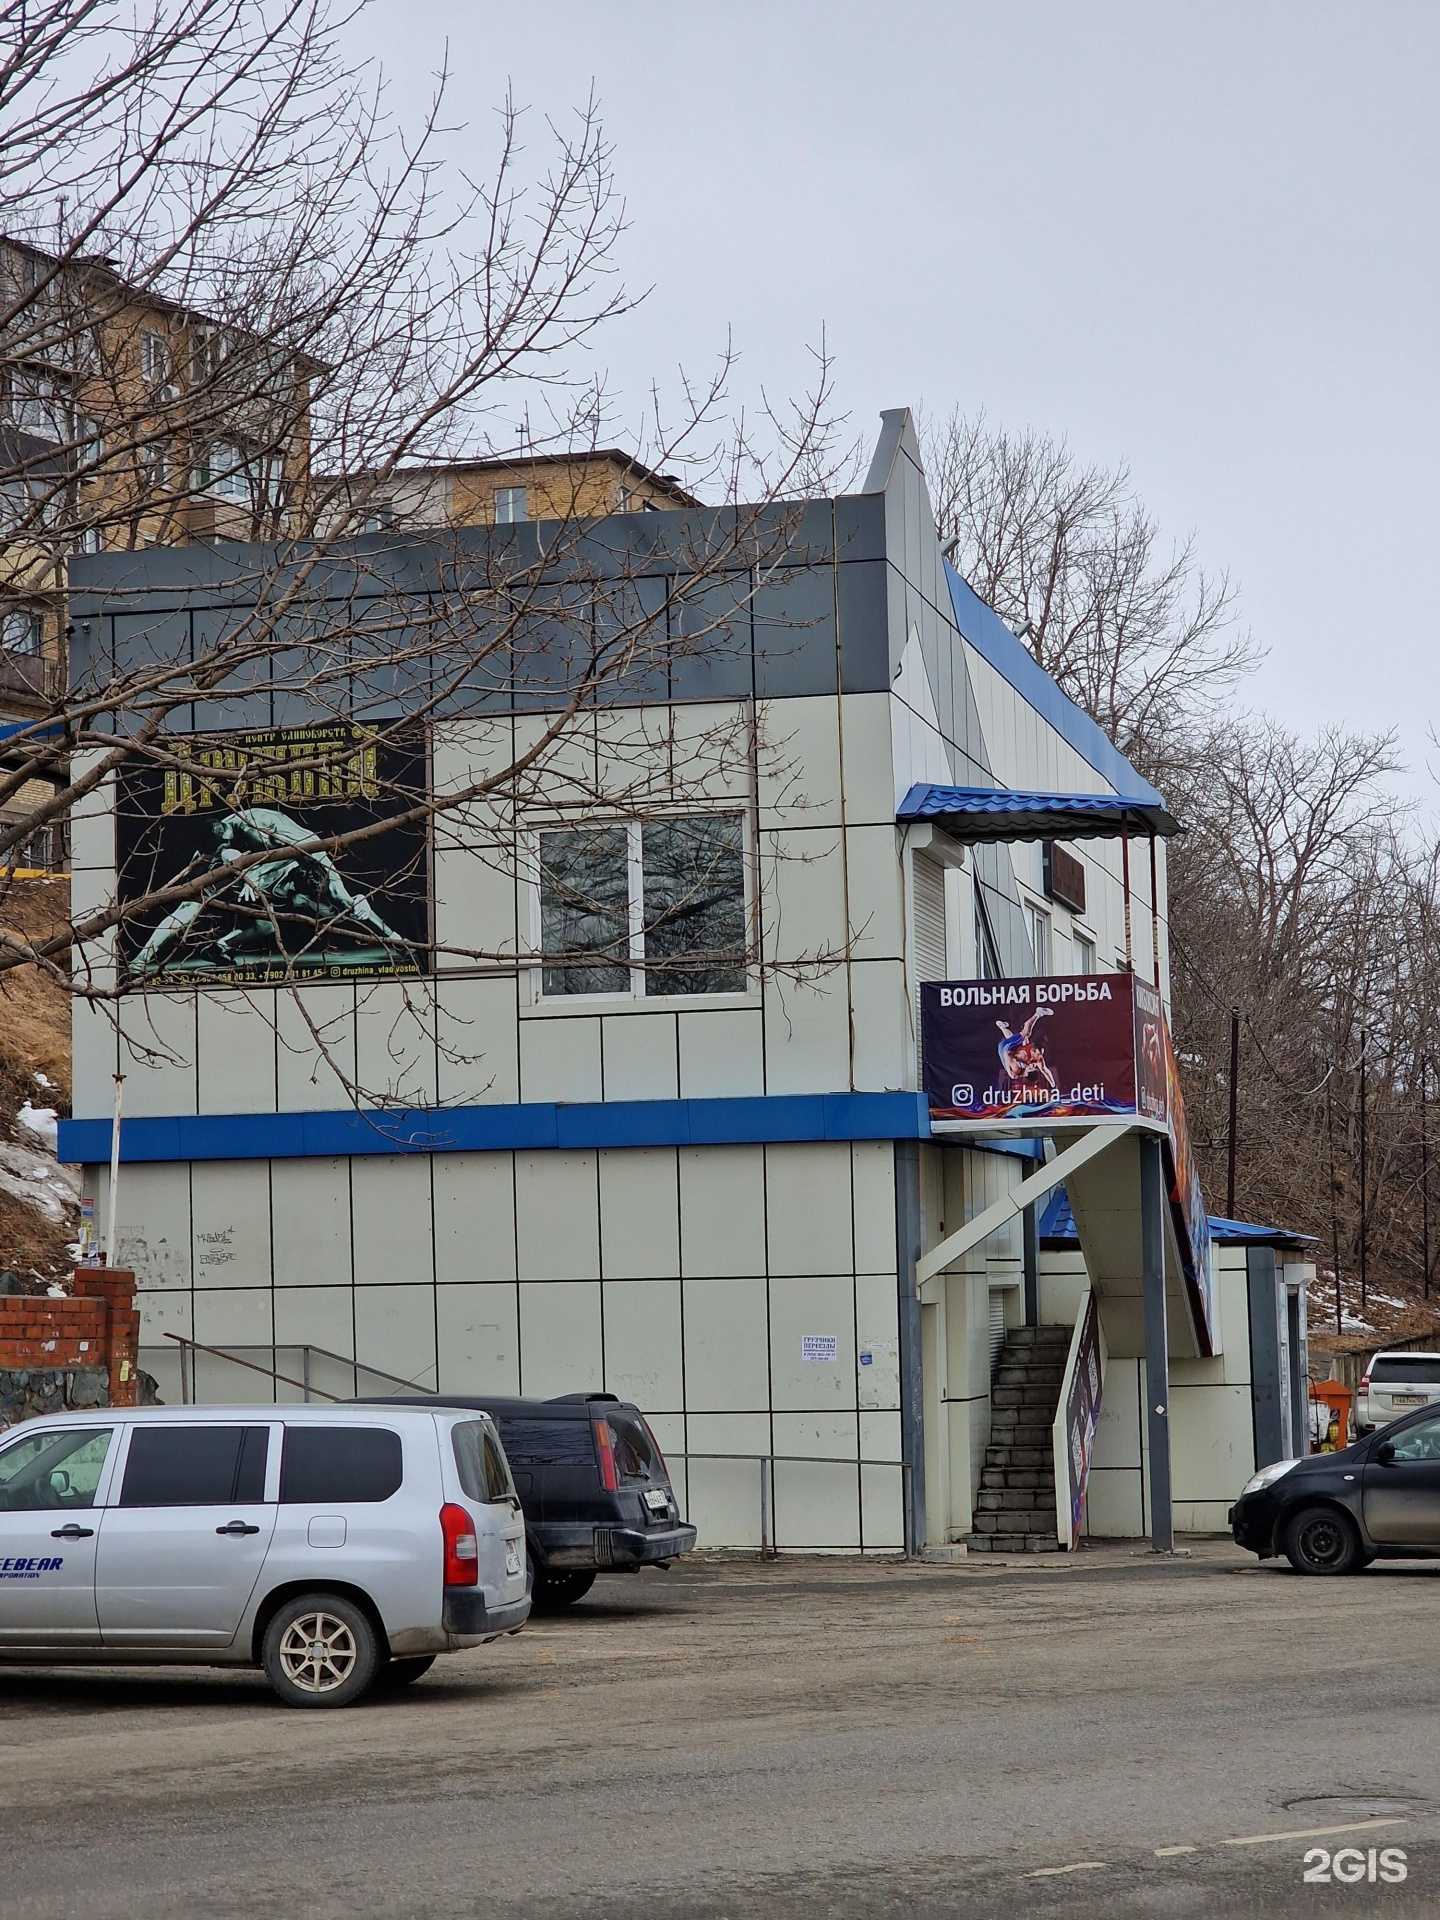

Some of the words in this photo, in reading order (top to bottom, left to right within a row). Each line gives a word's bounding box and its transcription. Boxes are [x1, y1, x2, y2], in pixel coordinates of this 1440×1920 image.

[940, 985, 1030, 1007] ВОЛЬНАЯ
[1035, 982, 1113, 1003] БОРЬБА
[982, 1083, 1105, 1106] druzhina_deti
